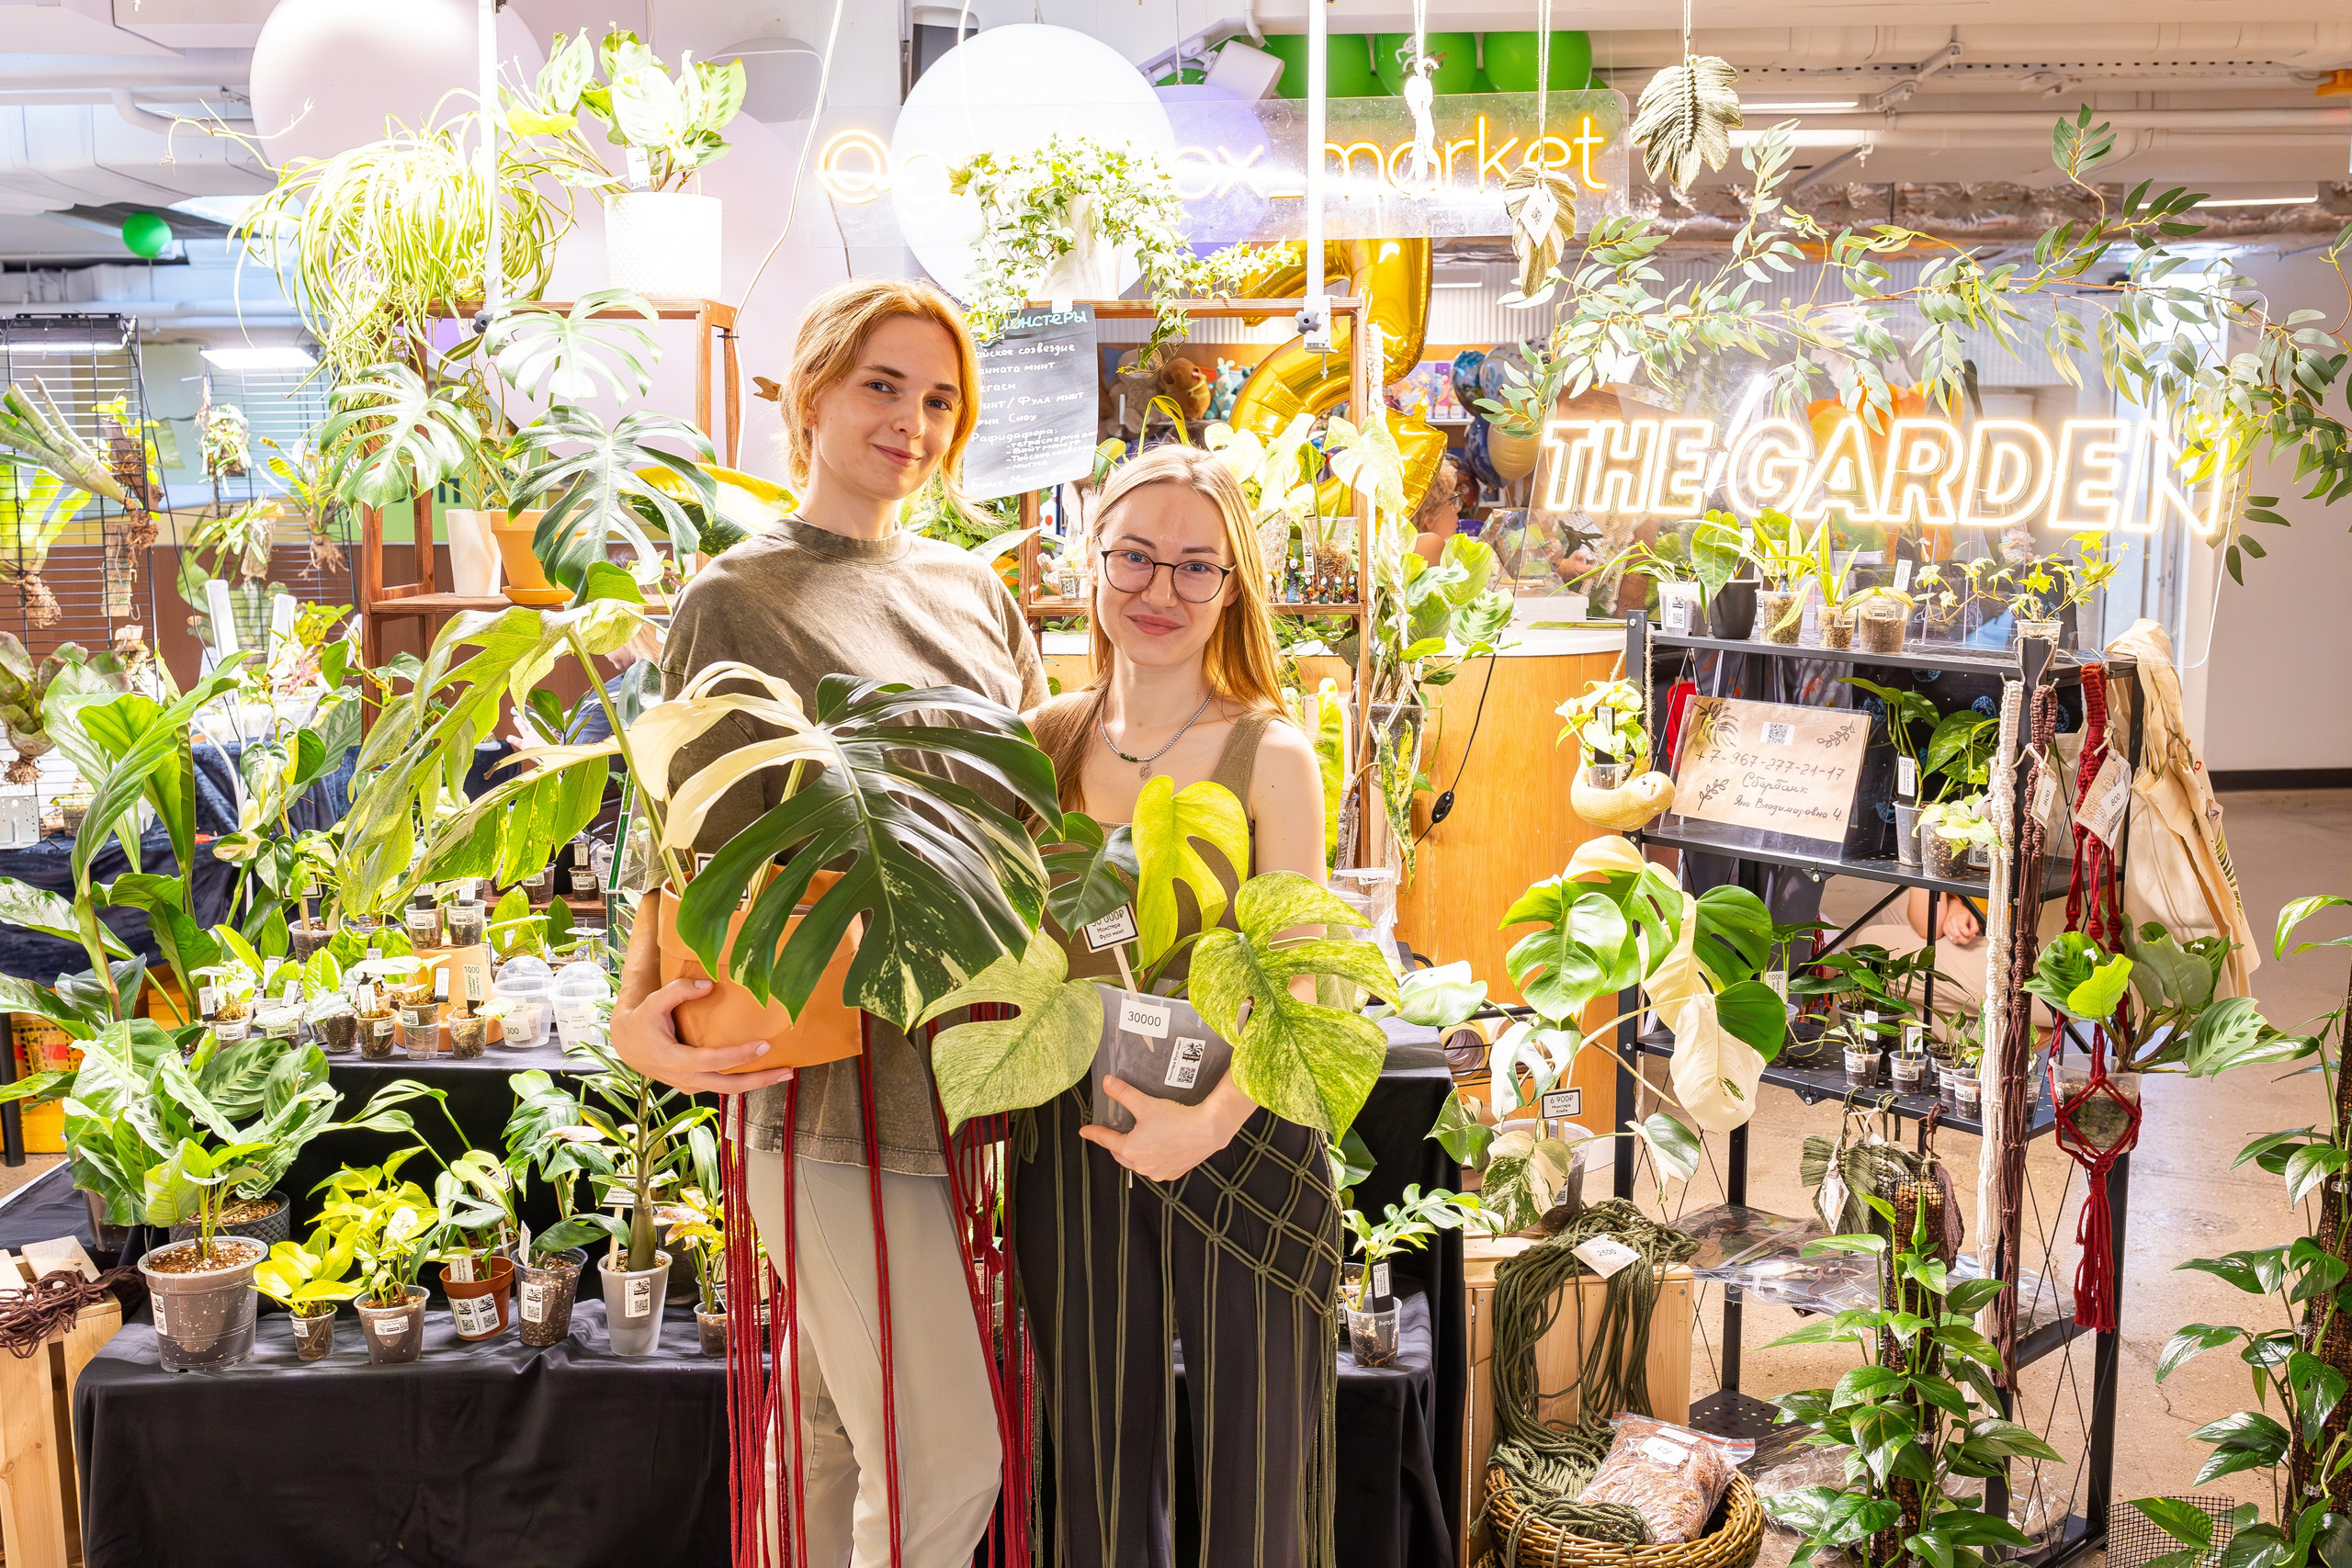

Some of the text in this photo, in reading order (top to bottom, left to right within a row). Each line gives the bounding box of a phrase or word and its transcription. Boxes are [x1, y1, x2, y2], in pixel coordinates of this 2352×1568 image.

[1018, 342, 1076, 356] созвездие
[1023, 361, 1056, 371] минт
[979, 382, 1016, 393] егаси
[1008, 412, 1037, 423] Сноу
[1542, 416, 2229, 537] THE GARDEN
[1742, 772, 1809, 795] Сбербанк
[2110, 793, 2121, 807] 800
[1734, 795, 1750, 807] Яна
[1755, 797, 1829, 819] Владимировна
[1097, 922, 1122, 934] Монстера
[464, 965, 481, 974] 1000
[1127, 1010, 1161, 1027] 30000
[506, 1027, 519, 1035] 300
[1550, 1096, 1555, 1104] 6
[1597, 1247, 1617, 1258] 2500
